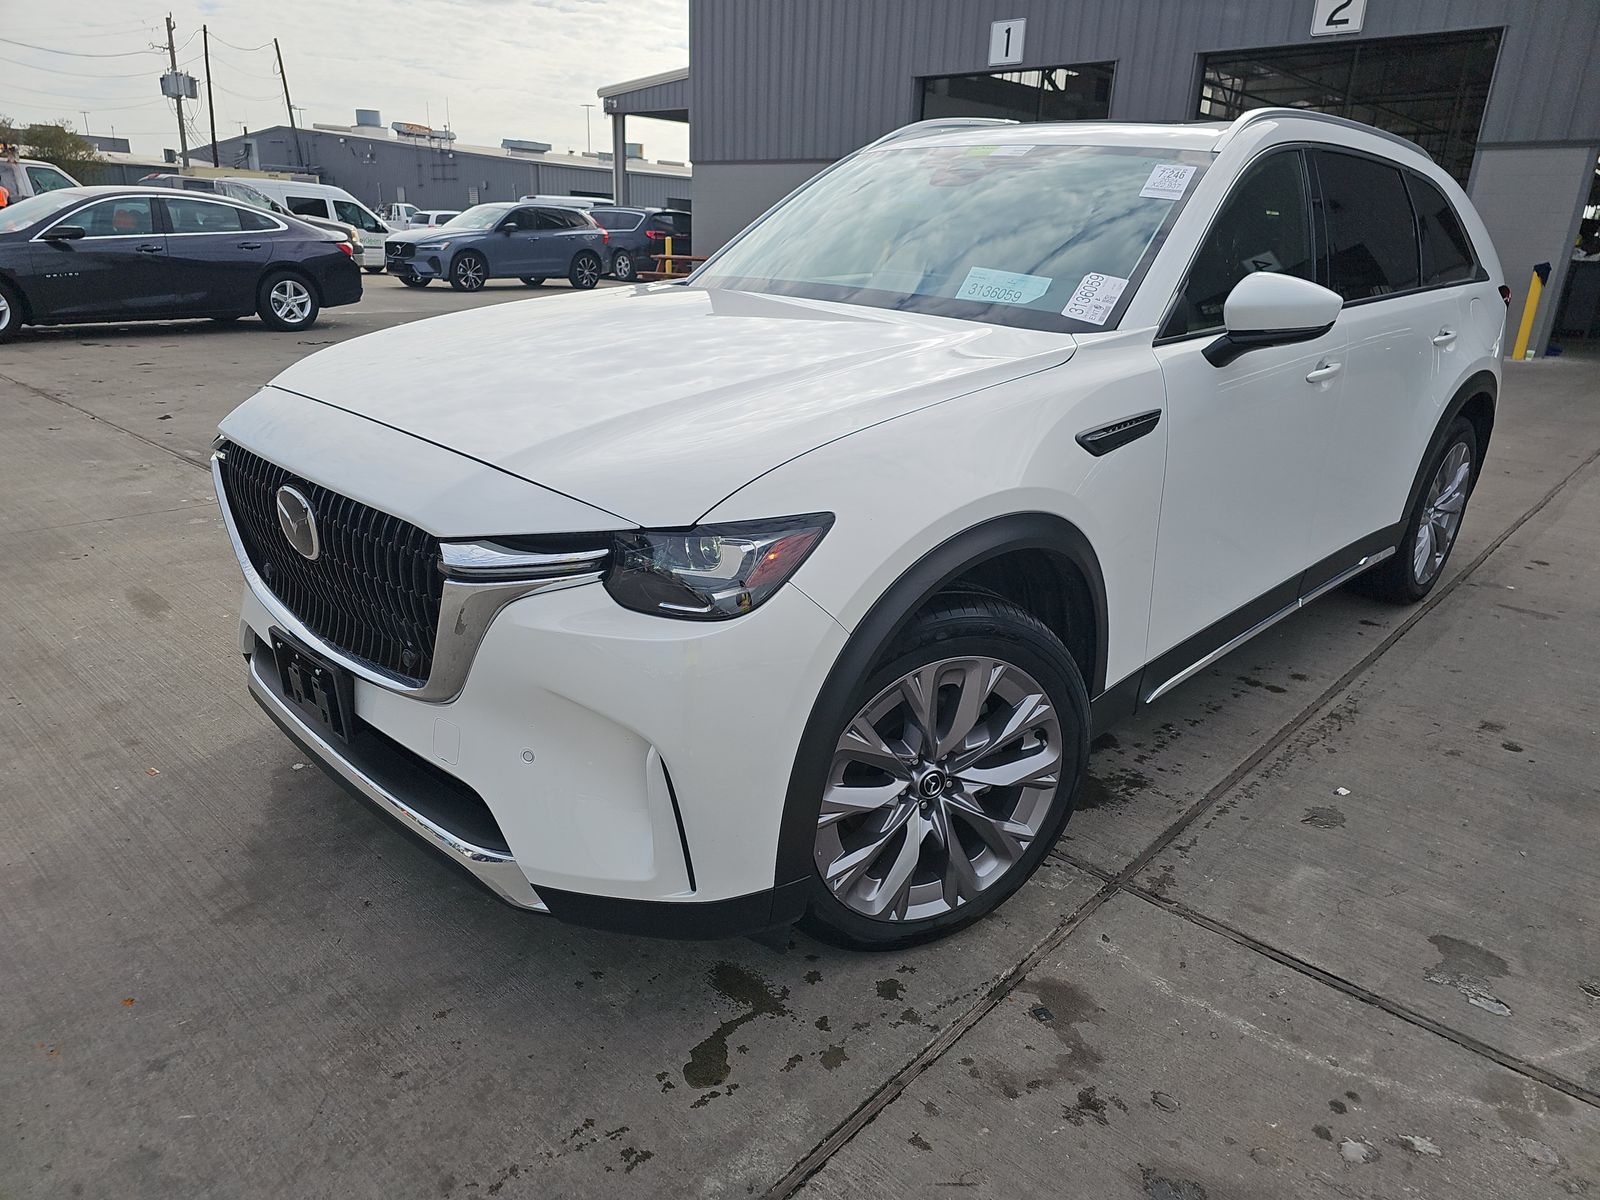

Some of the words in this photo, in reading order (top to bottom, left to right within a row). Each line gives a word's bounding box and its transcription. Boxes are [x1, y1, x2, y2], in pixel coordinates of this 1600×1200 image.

[1325, 0, 1353, 26] 2
[1004, 26, 1012, 58] 1
[968, 283, 1022, 303] 3136059
[1068, 274, 1105, 315] 3136059
